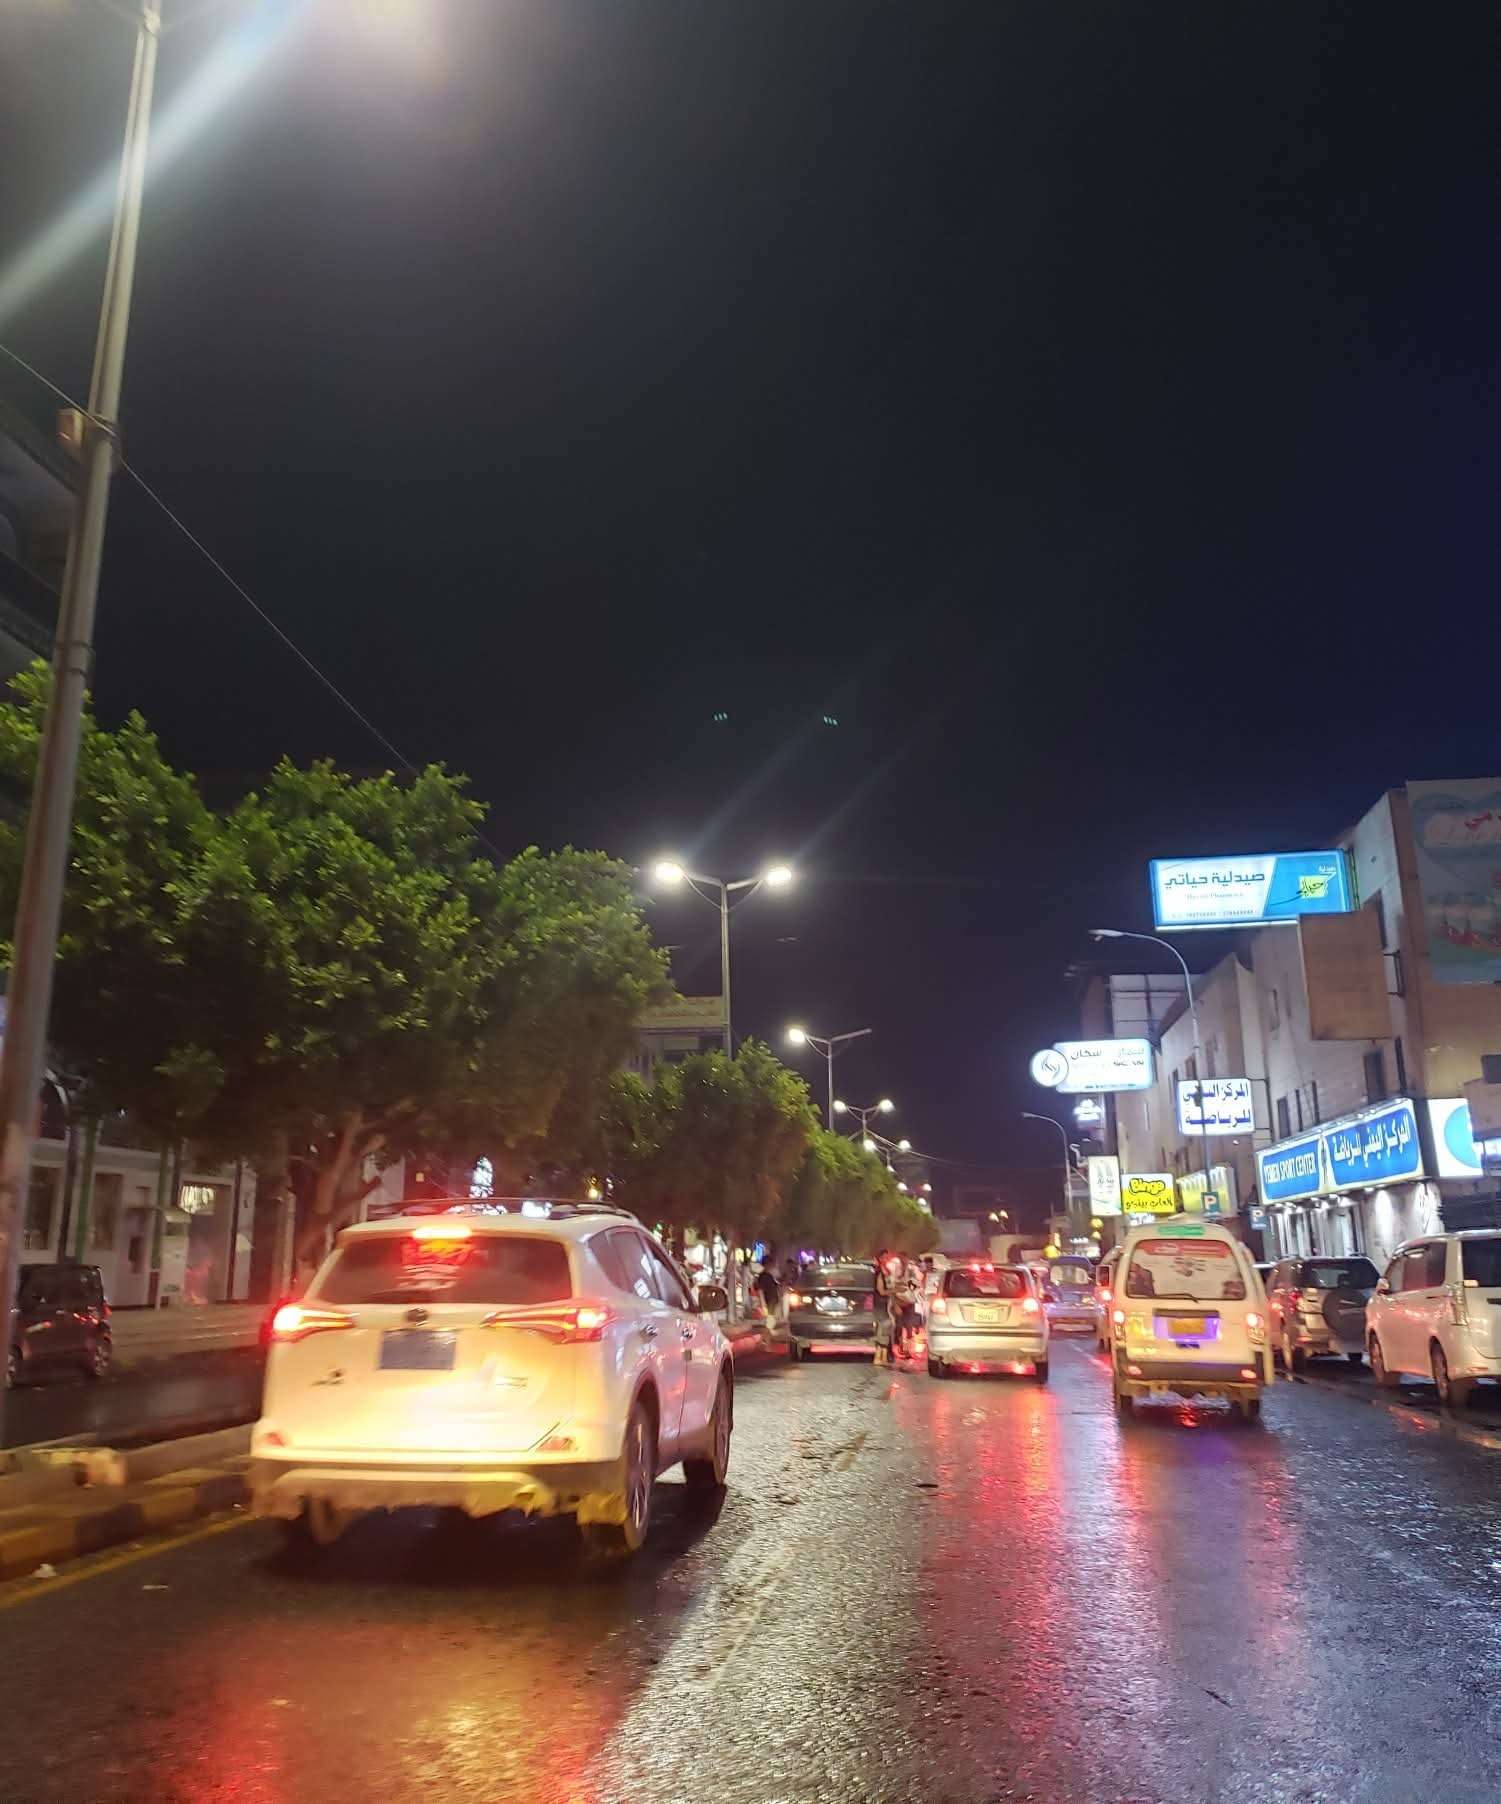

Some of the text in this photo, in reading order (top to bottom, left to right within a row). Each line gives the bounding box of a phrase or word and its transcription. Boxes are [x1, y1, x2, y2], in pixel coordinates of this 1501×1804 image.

[1164, 871, 1265, 889] صيدلية حياتي
[1222, 1081, 1249, 1101] المركز
[1185, 1108, 1251, 1128] للرياضة
[1332, 1114, 1411, 1167] المركز اليمني للرياضة
[1263, 1152, 1317, 1184] YEMEN SPORT CENTER
[1204, 1195, 1217, 1210] P
